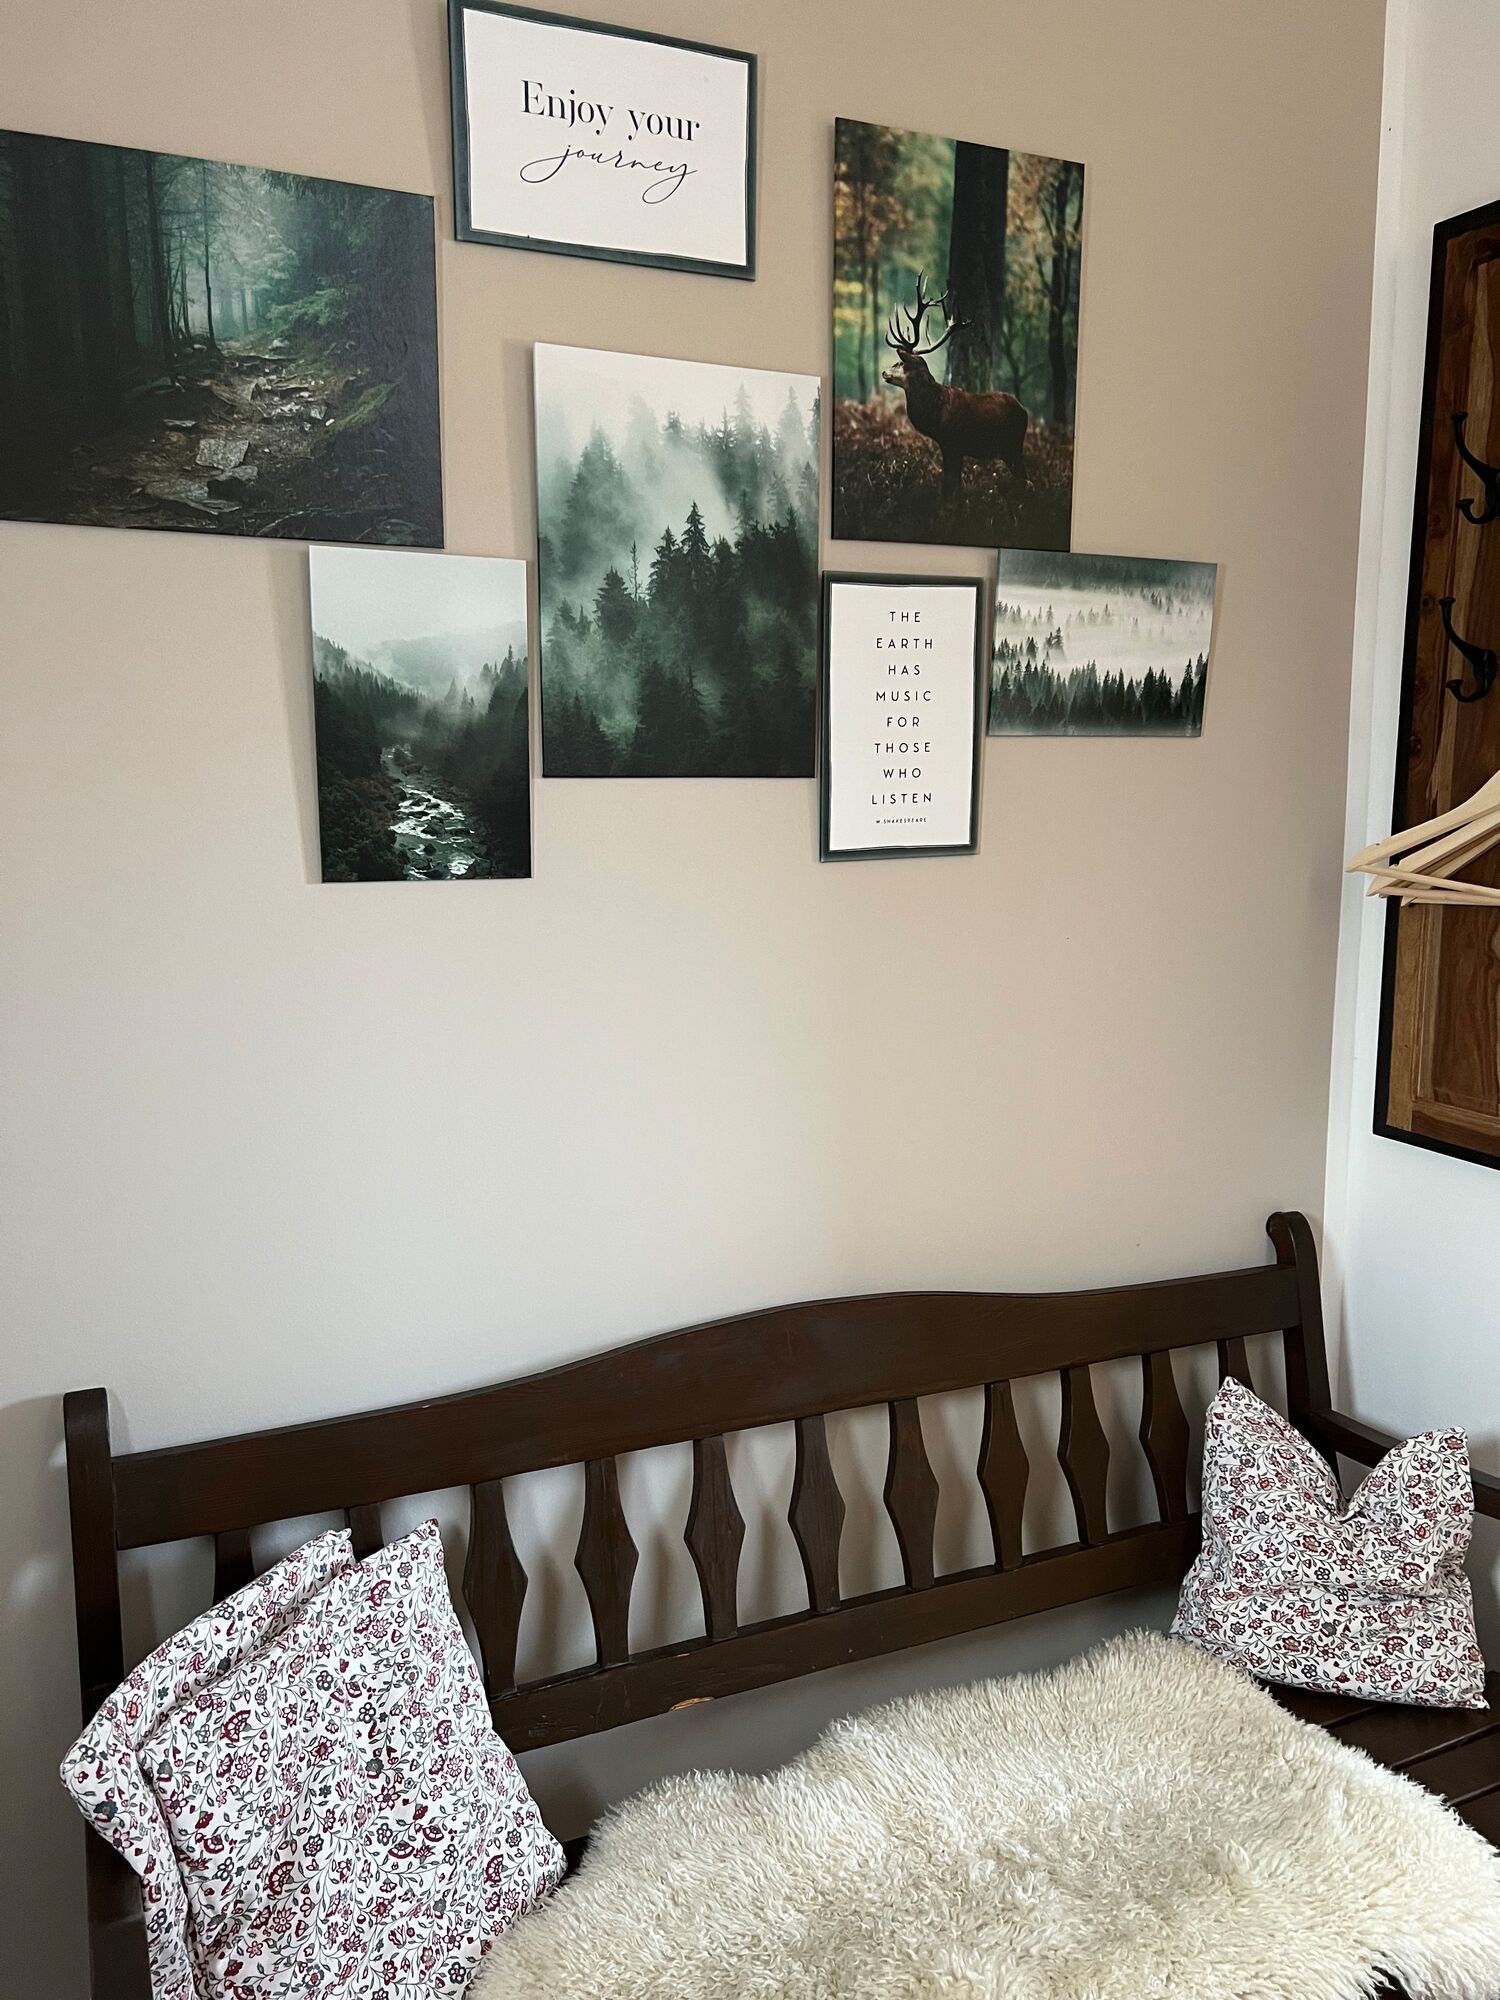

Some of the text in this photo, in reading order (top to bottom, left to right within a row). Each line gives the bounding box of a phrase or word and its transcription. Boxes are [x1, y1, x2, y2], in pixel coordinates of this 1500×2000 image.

[521, 79, 700, 141] Enjoy your
[519, 144, 698, 205] journey
[889, 611, 921, 623] THE
[876, 637, 933, 649] EARTH
[888, 664, 921, 676] HAS
[875, 690, 932, 702] MUSIC
[886, 716, 920, 728] FOR
[874, 741, 931, 754] THOSE
[882, 767, 922, 779] WHO
[871, 792, 932, 805] LISTEN
